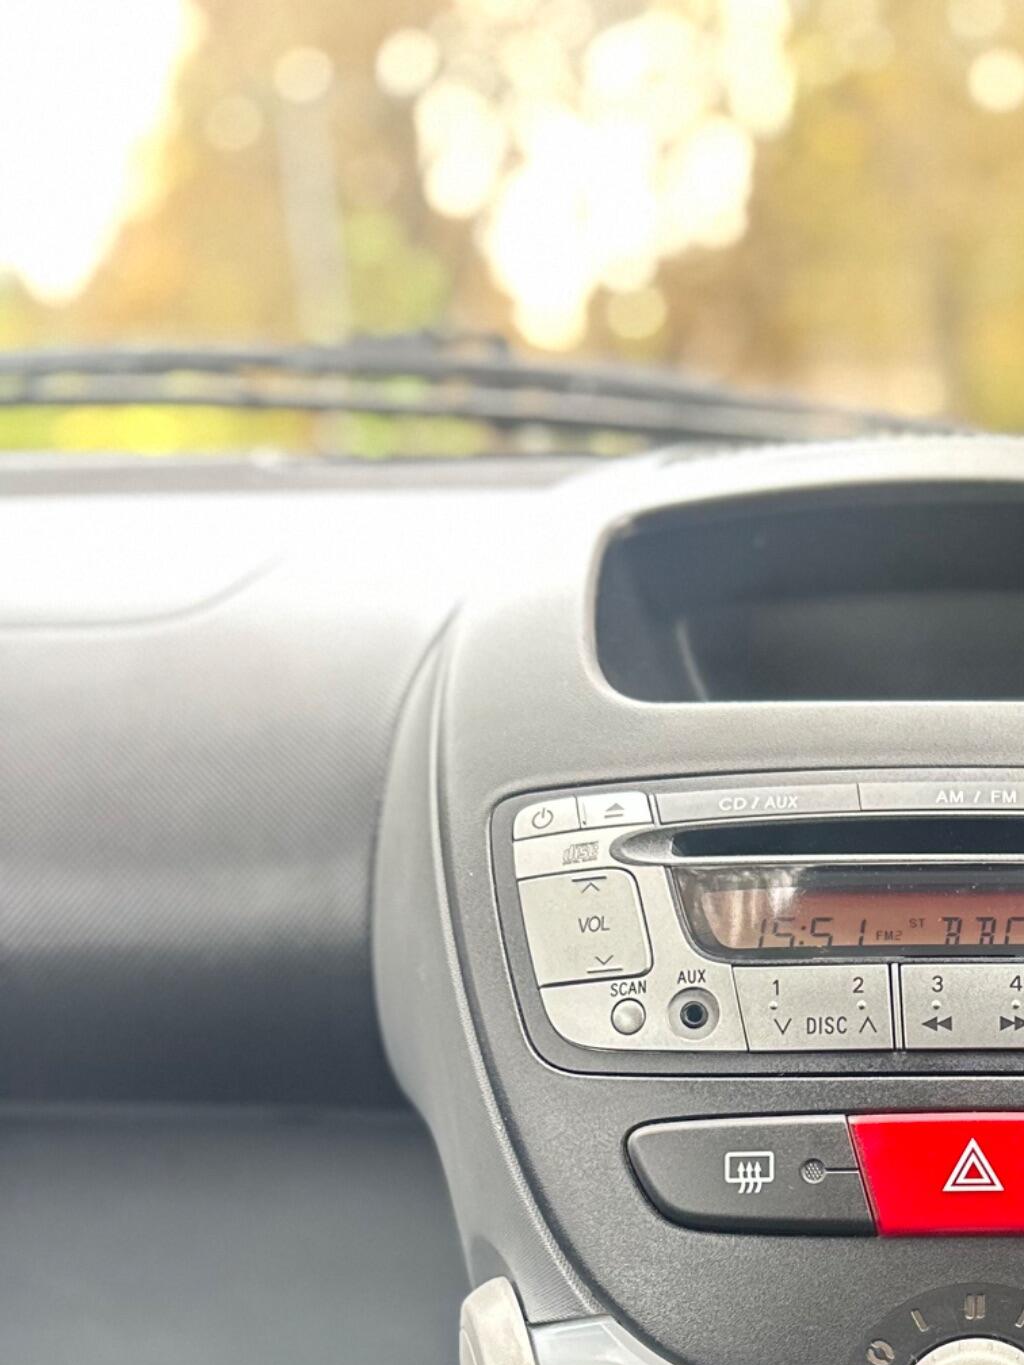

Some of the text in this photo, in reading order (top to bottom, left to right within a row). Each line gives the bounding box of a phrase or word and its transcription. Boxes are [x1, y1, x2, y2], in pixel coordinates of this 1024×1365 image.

[718, 796, 750, 811] CD
[763, 794, 798, 809] AUX
[935, 790, 965, 803] AM
[991, 790, 1017, 803] FM
[577, 915, 611, 933] VOL
[758, 916, 867, 947] 15:51
[908, 917, 926, 929] ST
[875, 930, 903, 942] FM2
[676, 968, 707, 985] AUX
[852, 977, 864, 993] 2
[931, 975, 944, 993] 3
[1008, 975, 1023, 993] 4
[609, 980, 648, 997] SCAN
[772, 979, 780, 995] 1
[806, 1015, 848, 1035] DISC
